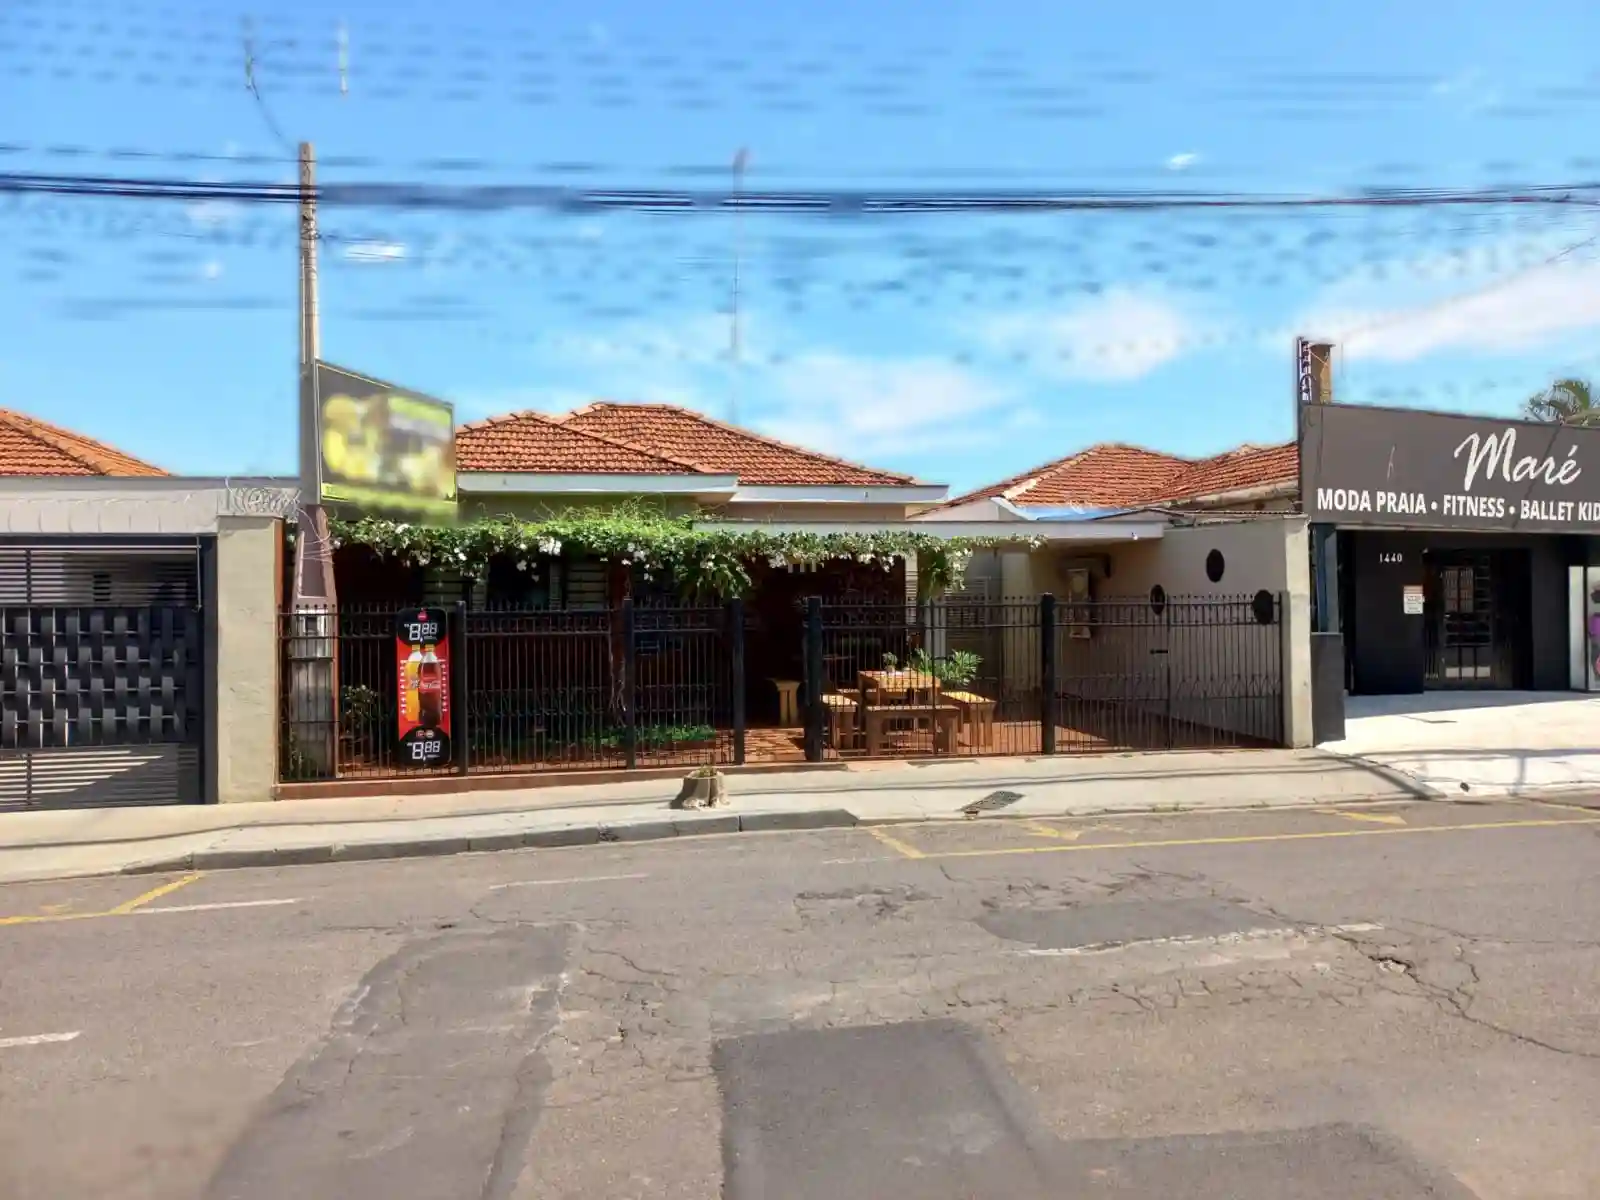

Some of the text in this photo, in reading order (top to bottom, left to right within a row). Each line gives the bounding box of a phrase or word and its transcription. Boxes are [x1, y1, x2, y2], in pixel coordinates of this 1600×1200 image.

[1453, 427, 1582, 492] Maré
[1317, 487, 1372, 513] MODA
[1376, 491, 1427, 515] PRAIA
[1443, 494, 1505, 518] FITNESS
[1520, 499, 1575, 521] BALLET
[1379, 552, 1403, 563] 1440
